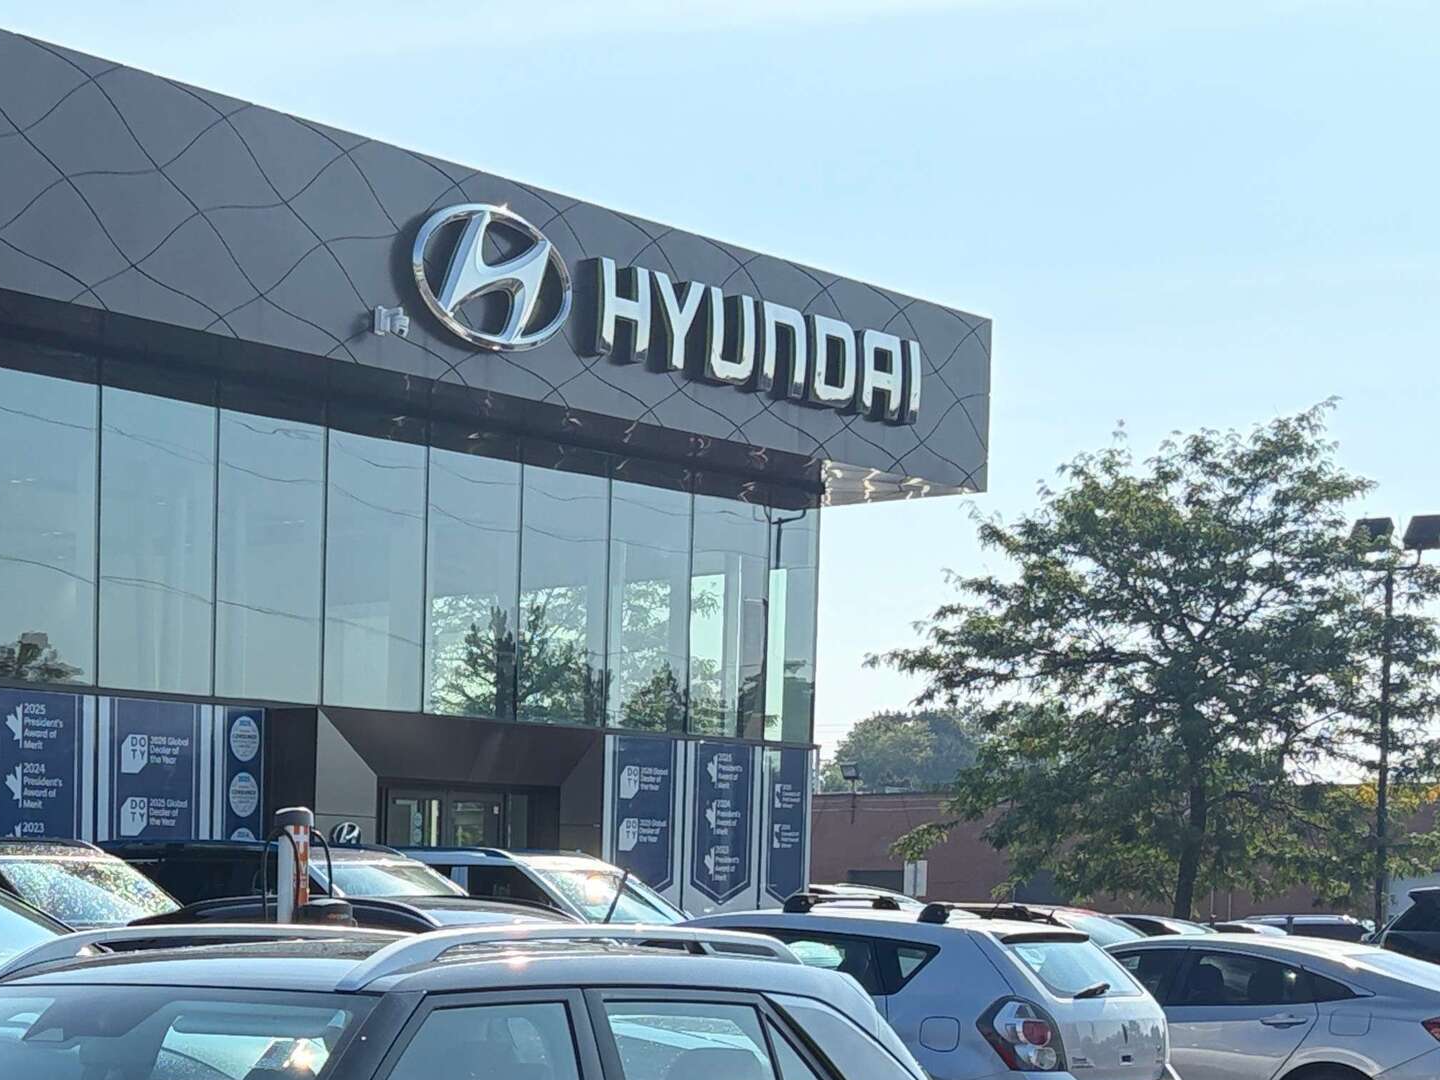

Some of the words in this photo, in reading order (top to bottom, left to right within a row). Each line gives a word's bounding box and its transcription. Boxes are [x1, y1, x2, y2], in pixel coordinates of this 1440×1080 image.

[594, 256, 922, 425] HYUNDAI
[23, 703, 46, 715] 2025
[23, 716, 64, 728] President's
[23, 728, 48, 739] Award
[48, 730, 57, 739] of
[23, 740, 43, 750] Merit
[130, 736, 146, 747] DO
[130, 748, 146, 761] TY
[23, 762, 46, 775] 2024
[627, 767, 638, 777] DO
[23, 775, 63, 788] President's
[23, 787, 47, 797] Award
[48, 789, 57, 798] of
[23, 799, 43, 809] Merit
[130, 799, 146, 810] DO
[130, 811, 146, 822] TY
[22, 822, 45, 833] 2023
[625, 820, 637, 829] DO
